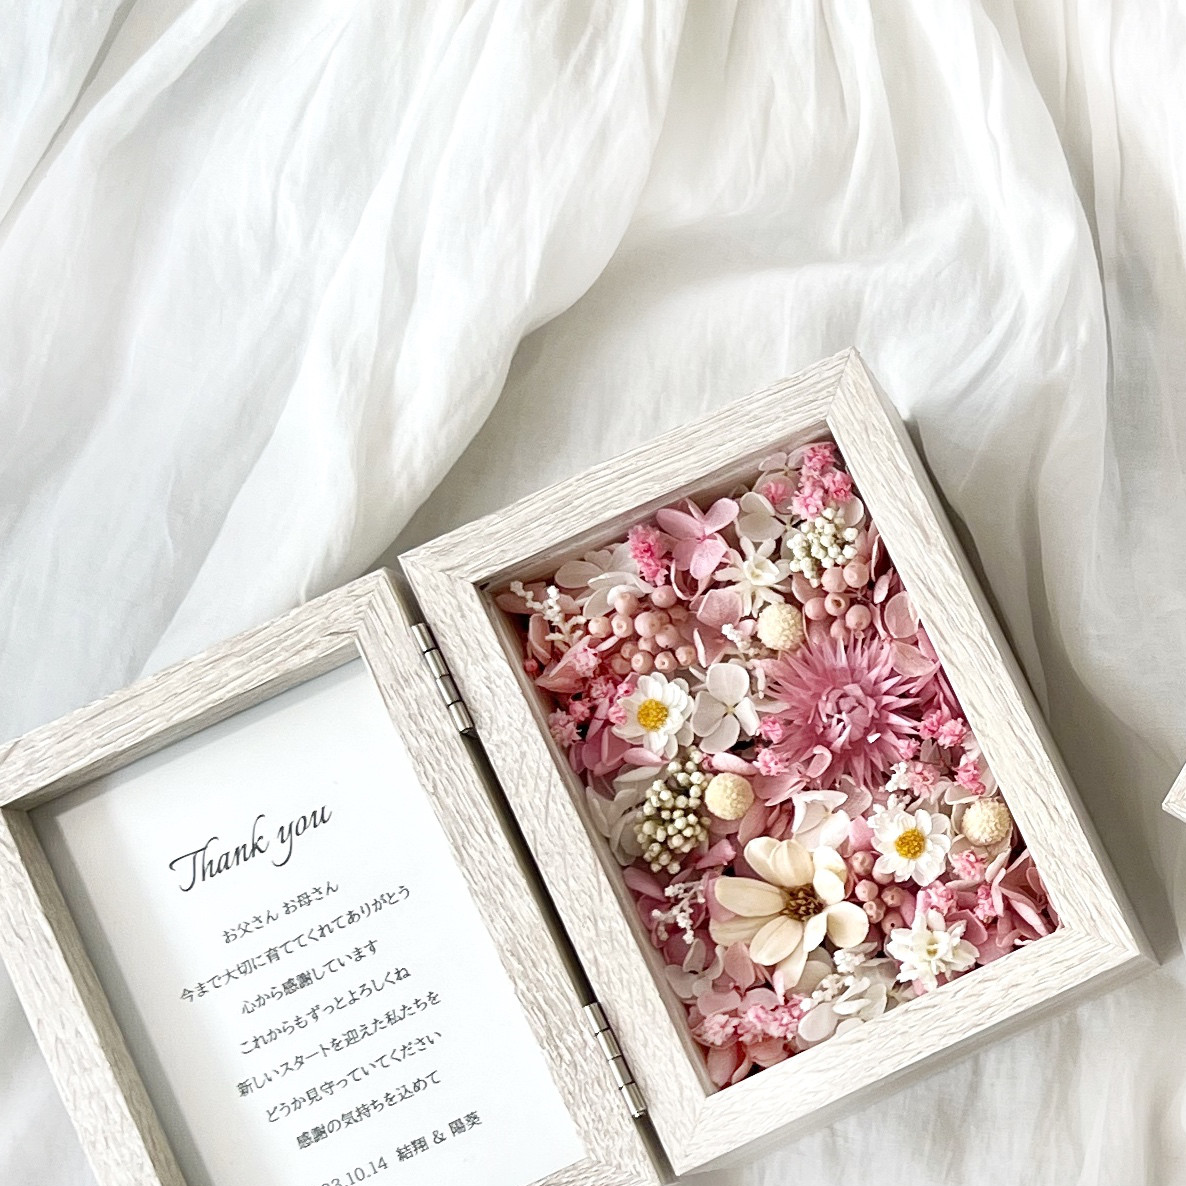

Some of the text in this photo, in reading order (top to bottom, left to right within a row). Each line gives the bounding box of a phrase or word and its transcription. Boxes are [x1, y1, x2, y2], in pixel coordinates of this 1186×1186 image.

[168, 803, 333, 892] Thank you
[179, 884, 412, 1003] 今まで大切に育ててくれてありがとう
[221, 879, 339, 945] お父さん お母さん
[240, 966, 412, 1057] これからもずっとよろしくね
[241, 939, 379, 1016] 心から感謝しています
[237, 990, 442, 1098] 新しいスタートを迎えた私たちを
[264, 1030, 443, 1123] どうか見守っていてください
[296, 1069, 442, 1150] 感謝の気持ちを込めて
[432, 1128, 447, 1147] &
